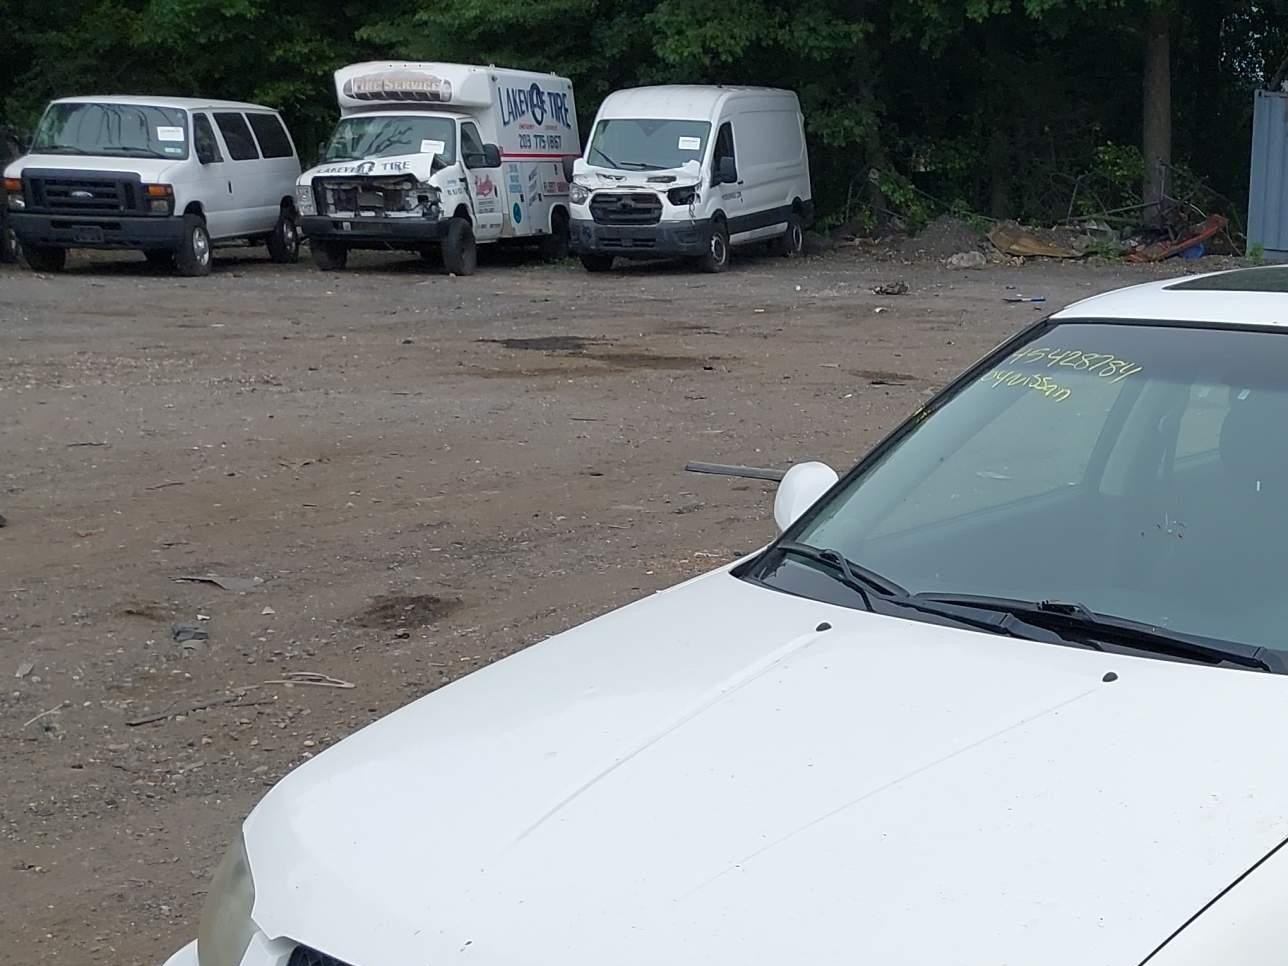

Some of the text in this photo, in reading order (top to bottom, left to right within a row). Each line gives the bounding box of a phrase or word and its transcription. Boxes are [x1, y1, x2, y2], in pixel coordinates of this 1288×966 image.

[546, 91, 572, 129] TIRE
[381, 160, 411, 173] TIRE
[1007, 346, 1143, 385] 45428784
